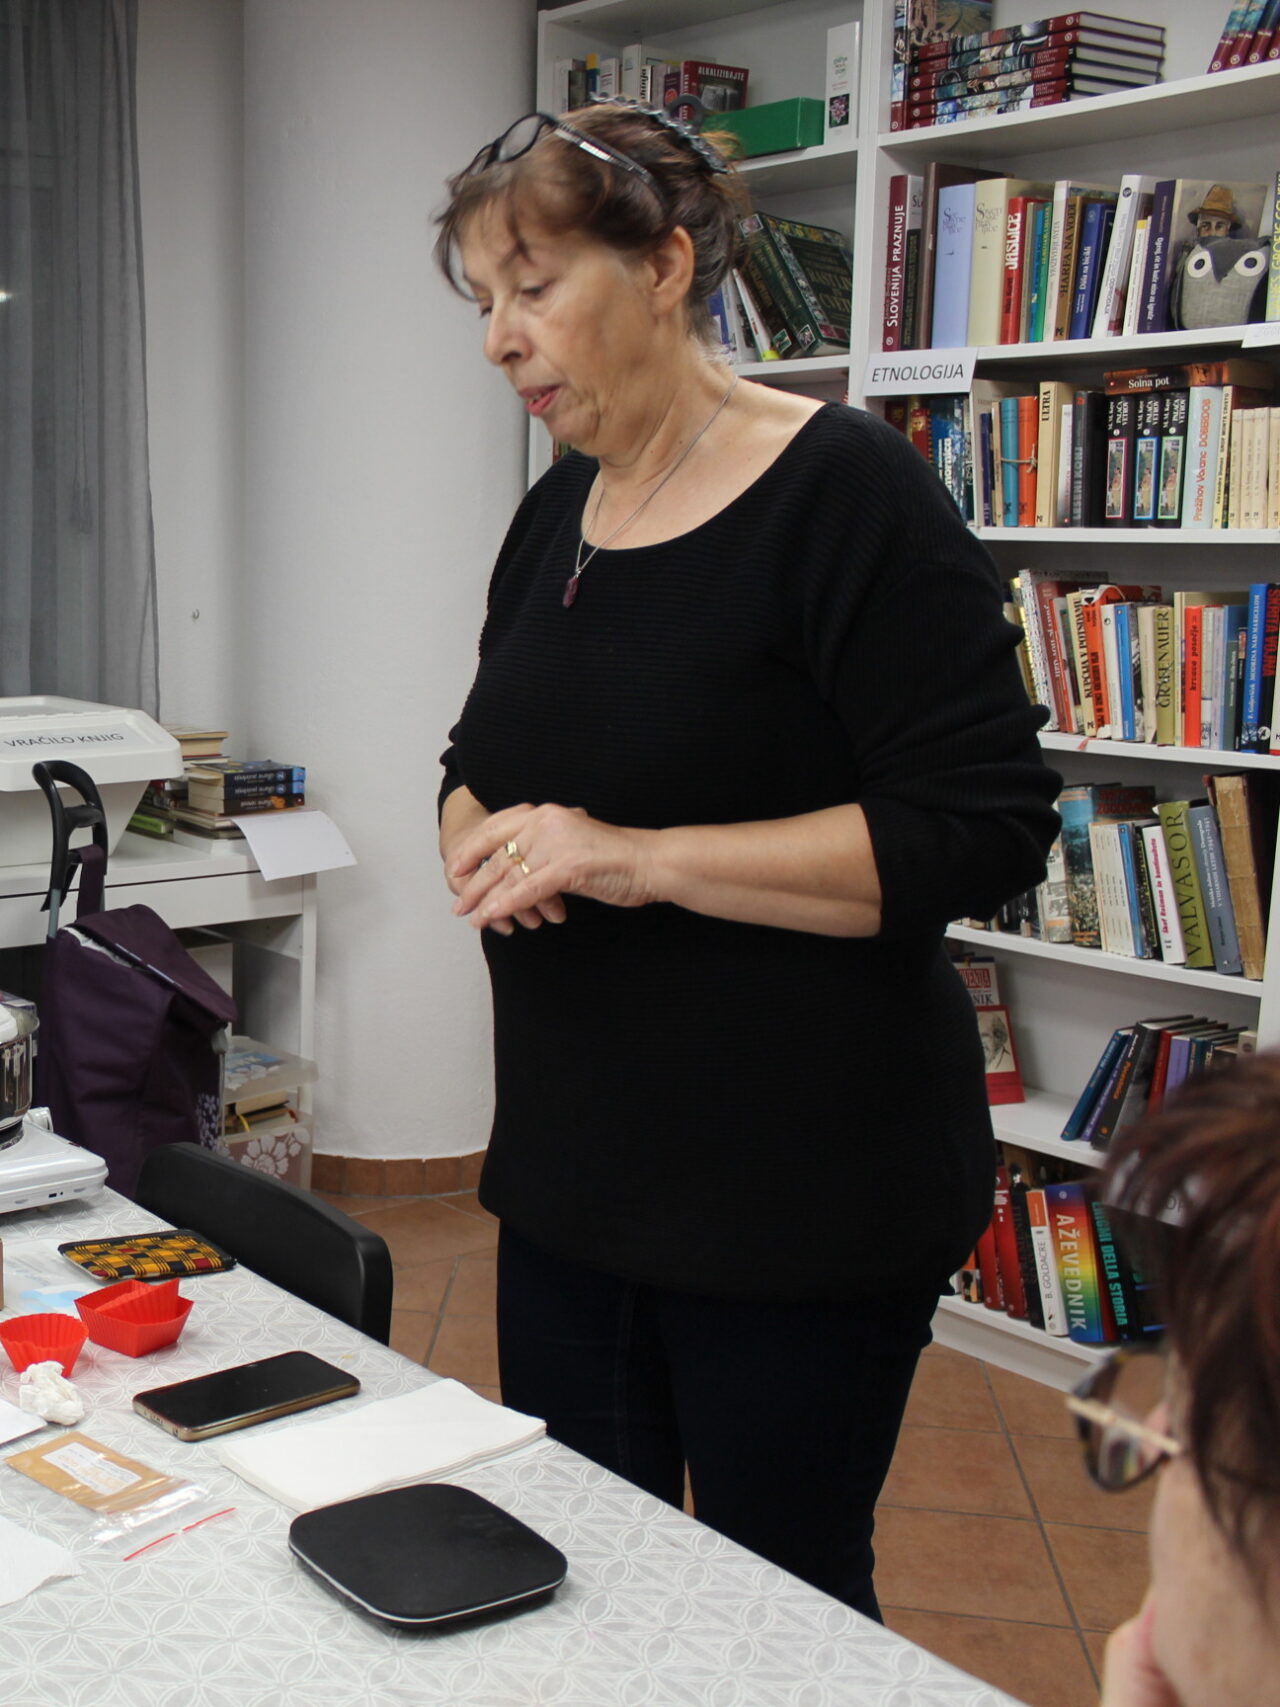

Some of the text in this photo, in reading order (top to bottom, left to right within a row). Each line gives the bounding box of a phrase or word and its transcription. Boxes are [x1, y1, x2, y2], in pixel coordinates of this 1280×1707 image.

[887, 204, 906, 327] SLOVENIJA PRAZNUJE
[1005, 212, 1022, 271] JASLICE
[1060, 203, 1076, 295] HARFA NA VODI
[871, 363, 964, 383] ETNOLOGIJA
[1128, 376, 1170, 389] Solna pot
[1041, 389, 1051, 423] ULTRA
[1172, 398, 1180, 422] PALAČA
[1073, 446, 1083, 520] LESENI KONJ
[1072, 597, 1093, 699] KUPČIJA V POTSDAMU
[1159, 609, 1171, 708] GRAFENAUER
[1262, 635, 1278, 677] VOJNA
[3, 731, 124, 749] VRAČILO KNJIG
[1166, 811, 1201, 957] VALVASOR
[1037, 1241, 1052, 1289] GOLDACRE
[1056, 1214, 1087, 1330] AŽEVEDNIK
[1101, 1245, 1120, 1280] DELLA
[1109, 1283, 1128, 1326] STORIA
